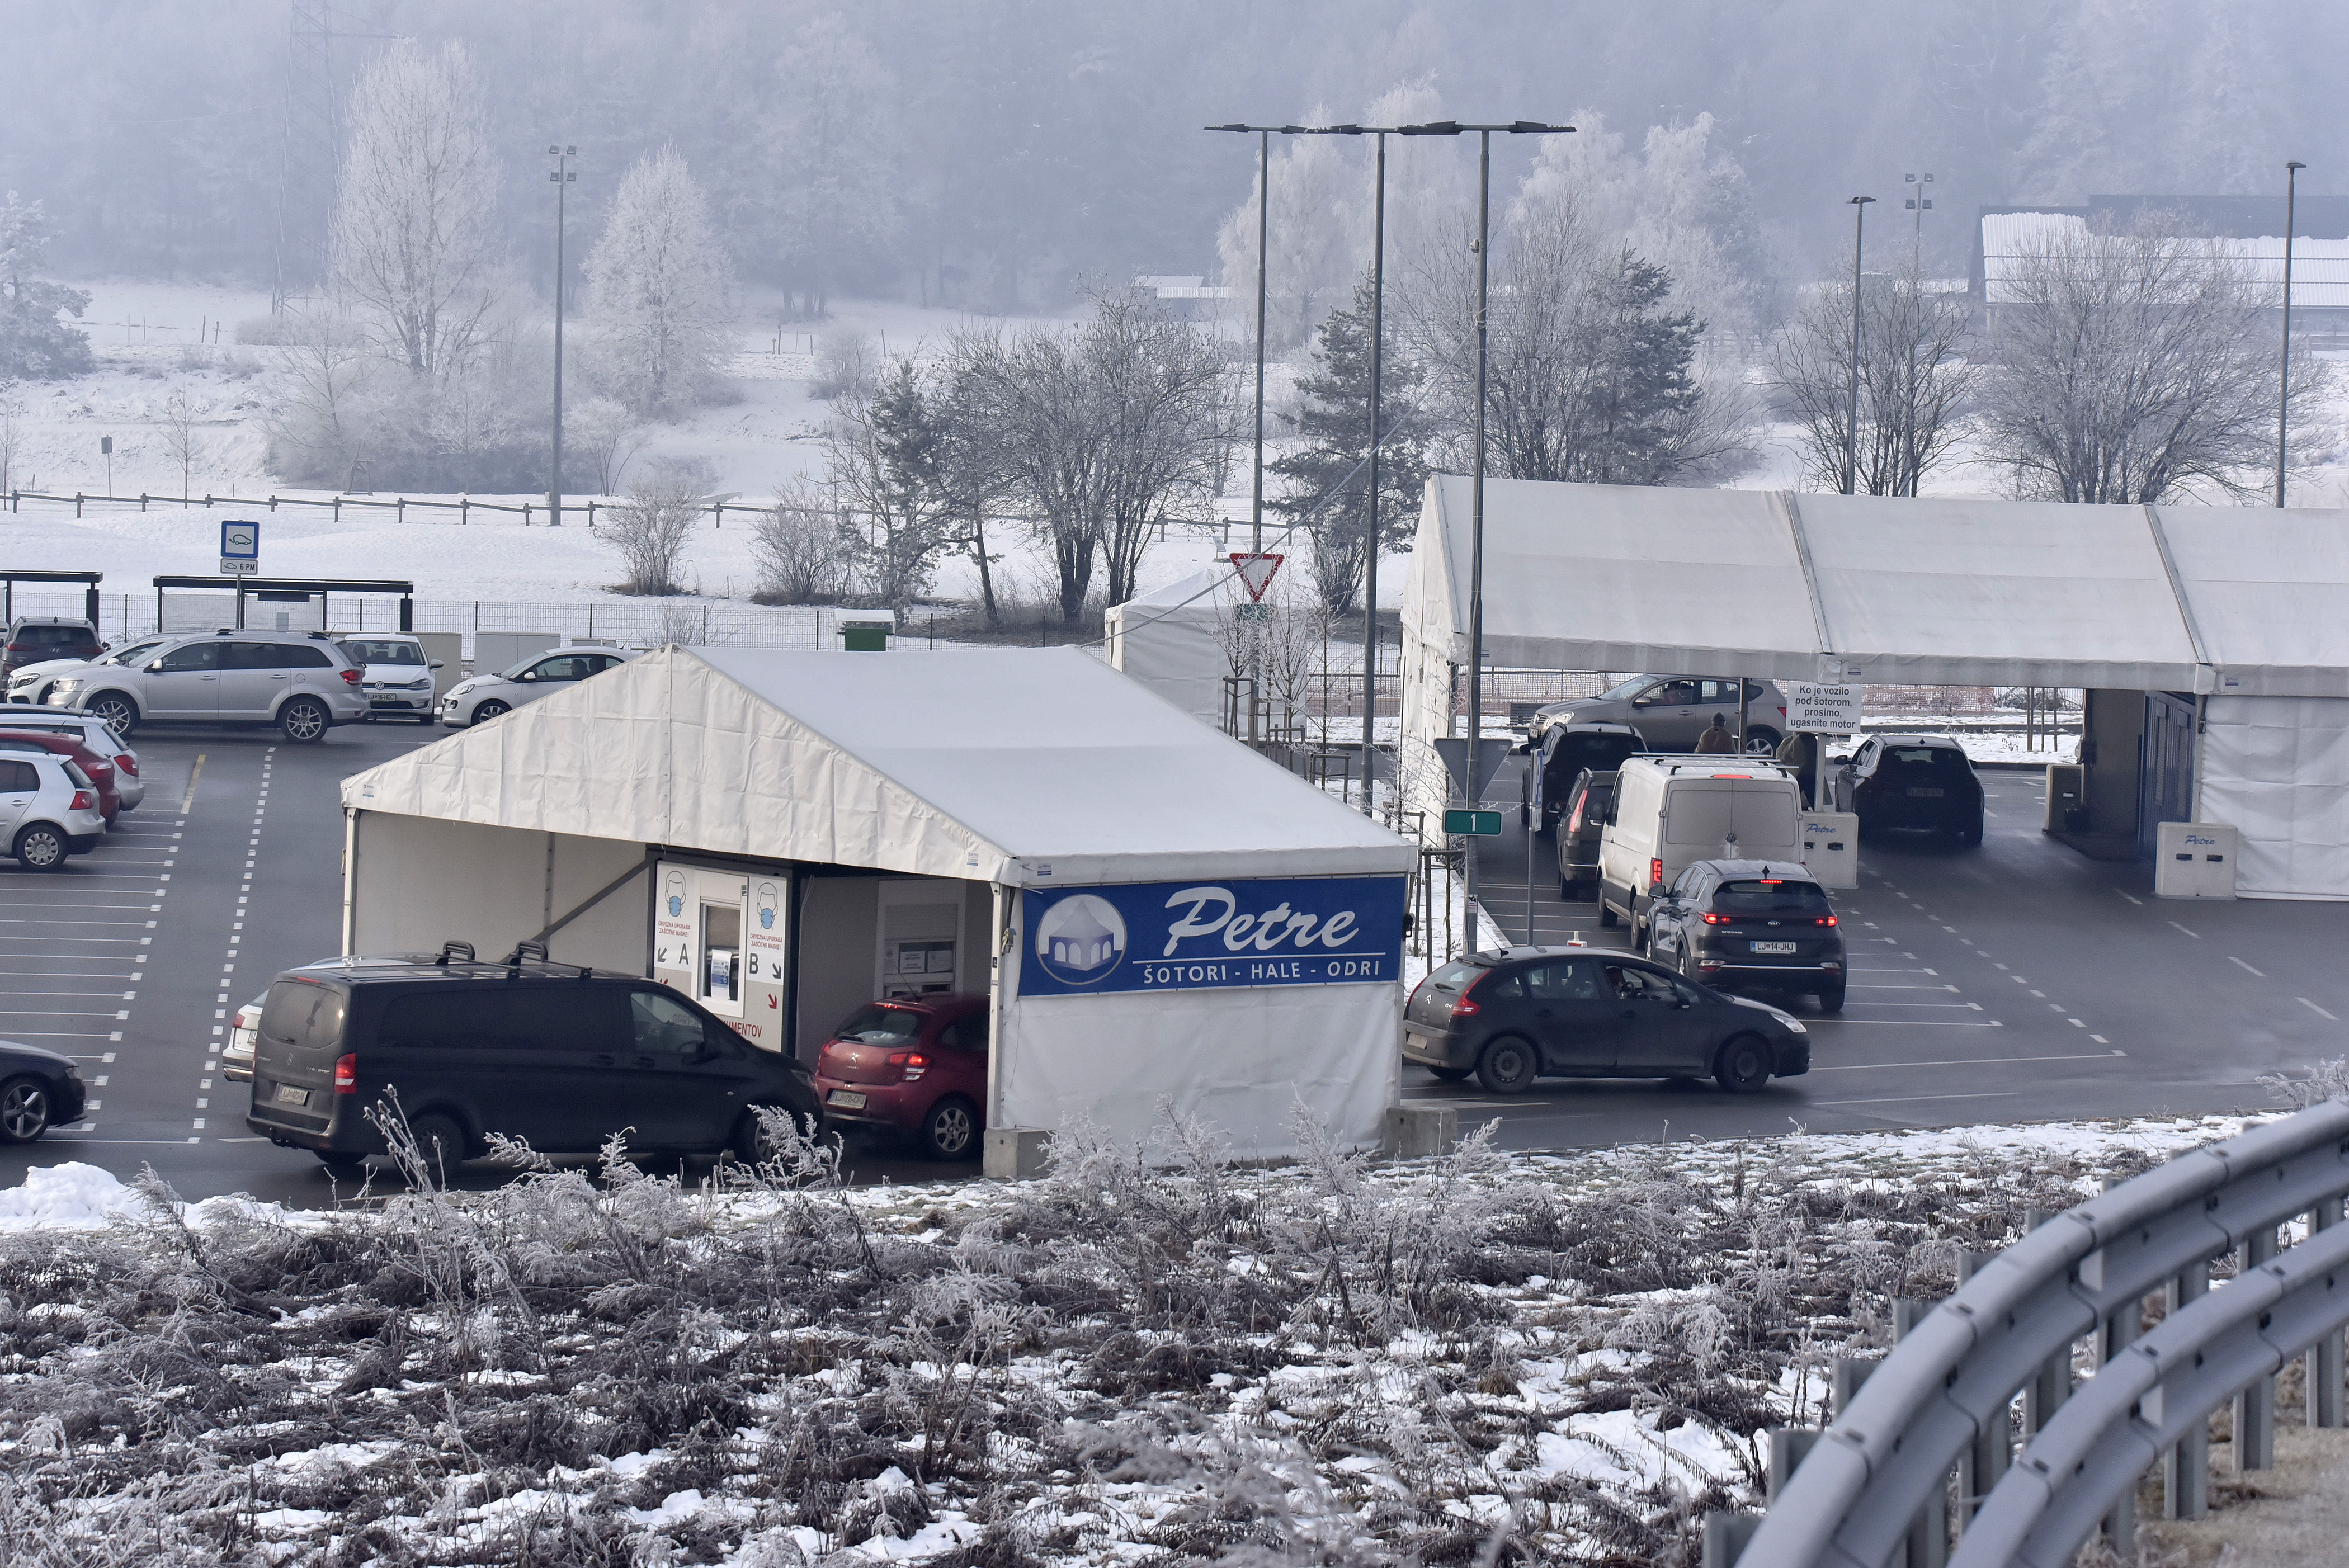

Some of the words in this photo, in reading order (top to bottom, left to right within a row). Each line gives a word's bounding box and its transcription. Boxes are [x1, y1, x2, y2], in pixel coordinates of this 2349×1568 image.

[1799, 685, 1812, 694] Ko
[1813, 686, 1822, 696] je
[1824, 687, 1850, 695] vozilo
[1795, 697, 1812, 706] pod
[1814, 696, 1852, 707] šotorom,
[1804, 708, 1842, 719] prosimo,
[1791, 719, 1827, 728] ugasnite
[1471, 814, 1476, 832] 1
[1806, 823, 1837, 833] Petre
[2185, 835, 2216, 845] Petre
[1163, 886, 1359, 957] Petre
[678, 943, 689, 965] A
[749, 953, 758, 974] B
[1144, 963, 1227, 984] ŠOTORI
[1251, 961, 1301, 979] HALE
[1327, 960, 1380, 976] ODRI
[723, 1020, 762, 1037] MENTOV
